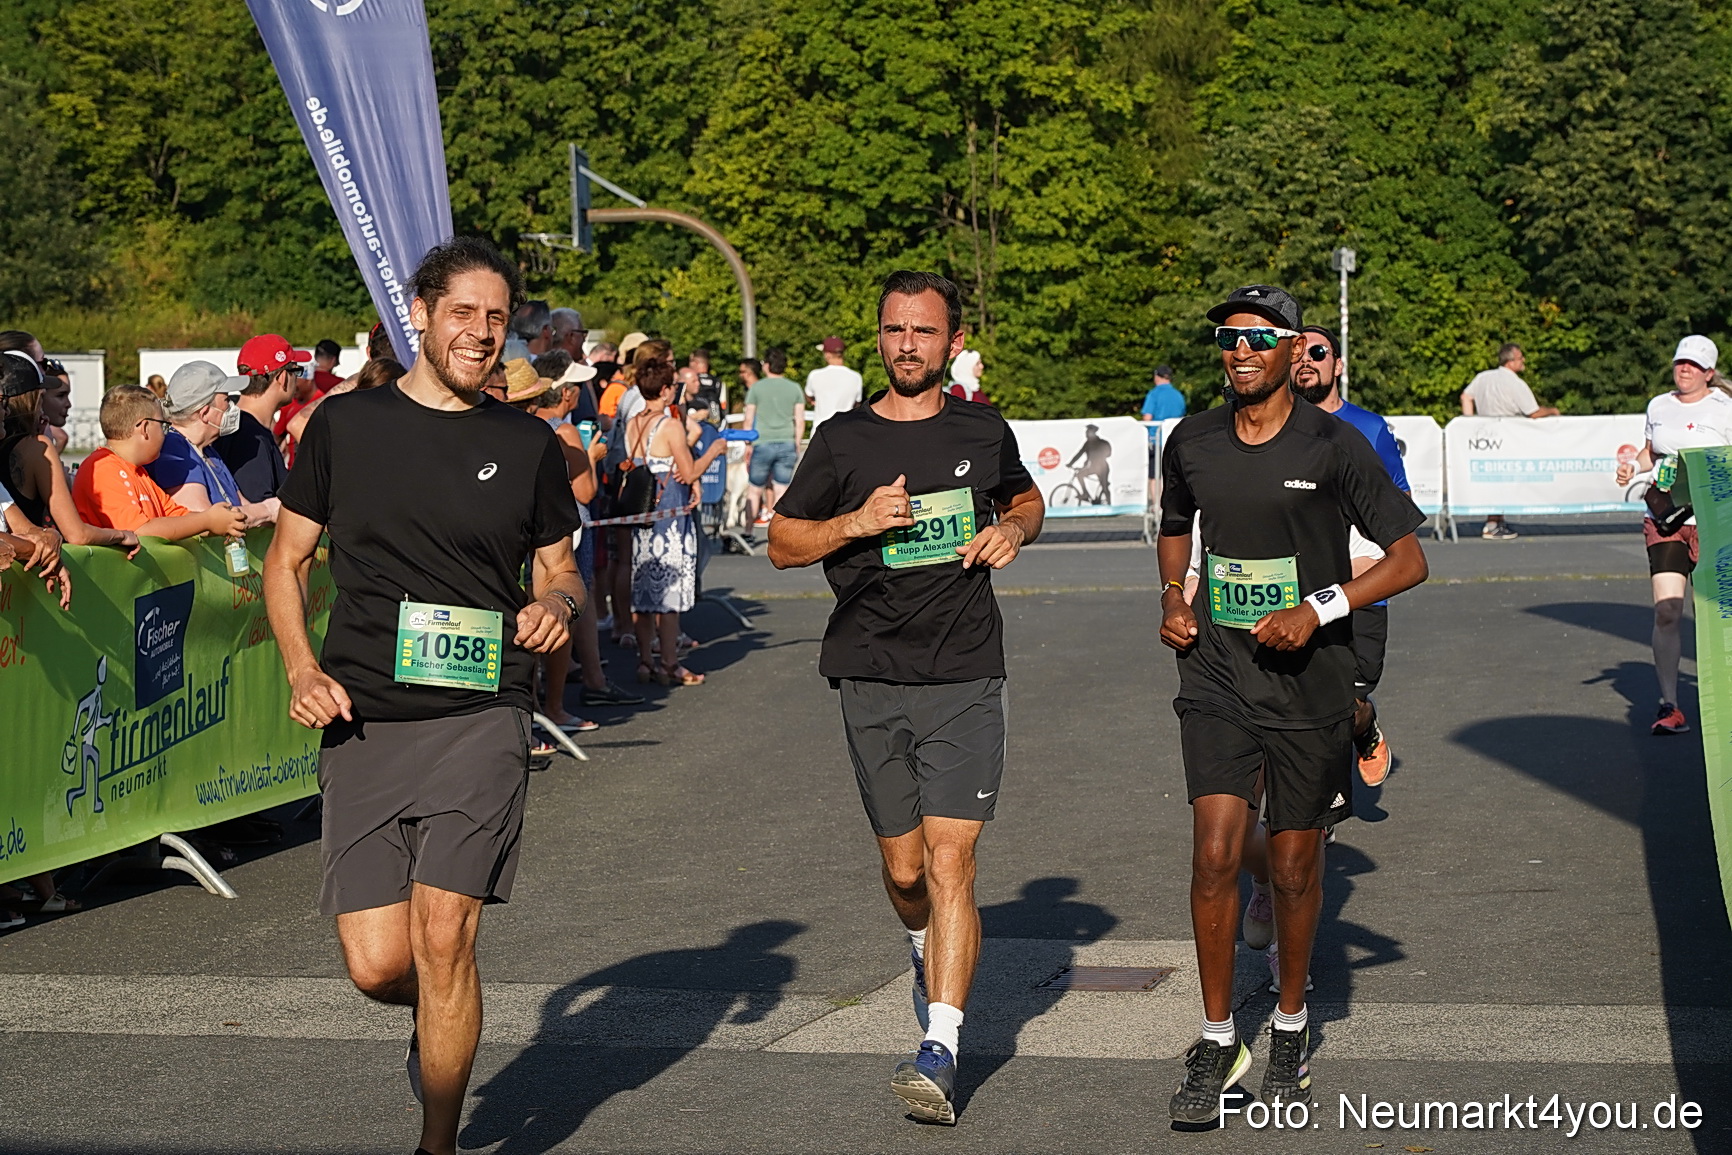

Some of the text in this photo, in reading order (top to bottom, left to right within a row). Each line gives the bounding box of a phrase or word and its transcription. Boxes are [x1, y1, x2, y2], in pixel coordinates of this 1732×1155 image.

[1468, 438, 1503, 450] NOW
[1525, 459, 1536, 473] &
[1283, 479, 1317, 490] adidas
[895, 539, 965, 556] Hupp Alexander
[1212, 586, 1222, 612] RUN
[1221, 581, 1283, 607] 1059
[1226, 606, 1250, 617] Koller
[146, 619, 180, 649] Fischer
[402, 639, 413, 667] RUN
[416, 631, 486, 664] 1058
[411, 658, 488, 675] Fischer Sebastian
[486, 643, 497, 679] 2022
[110, 655, 230, 774] firmenlauf
[110, 754, 167, 802] neumarkt
